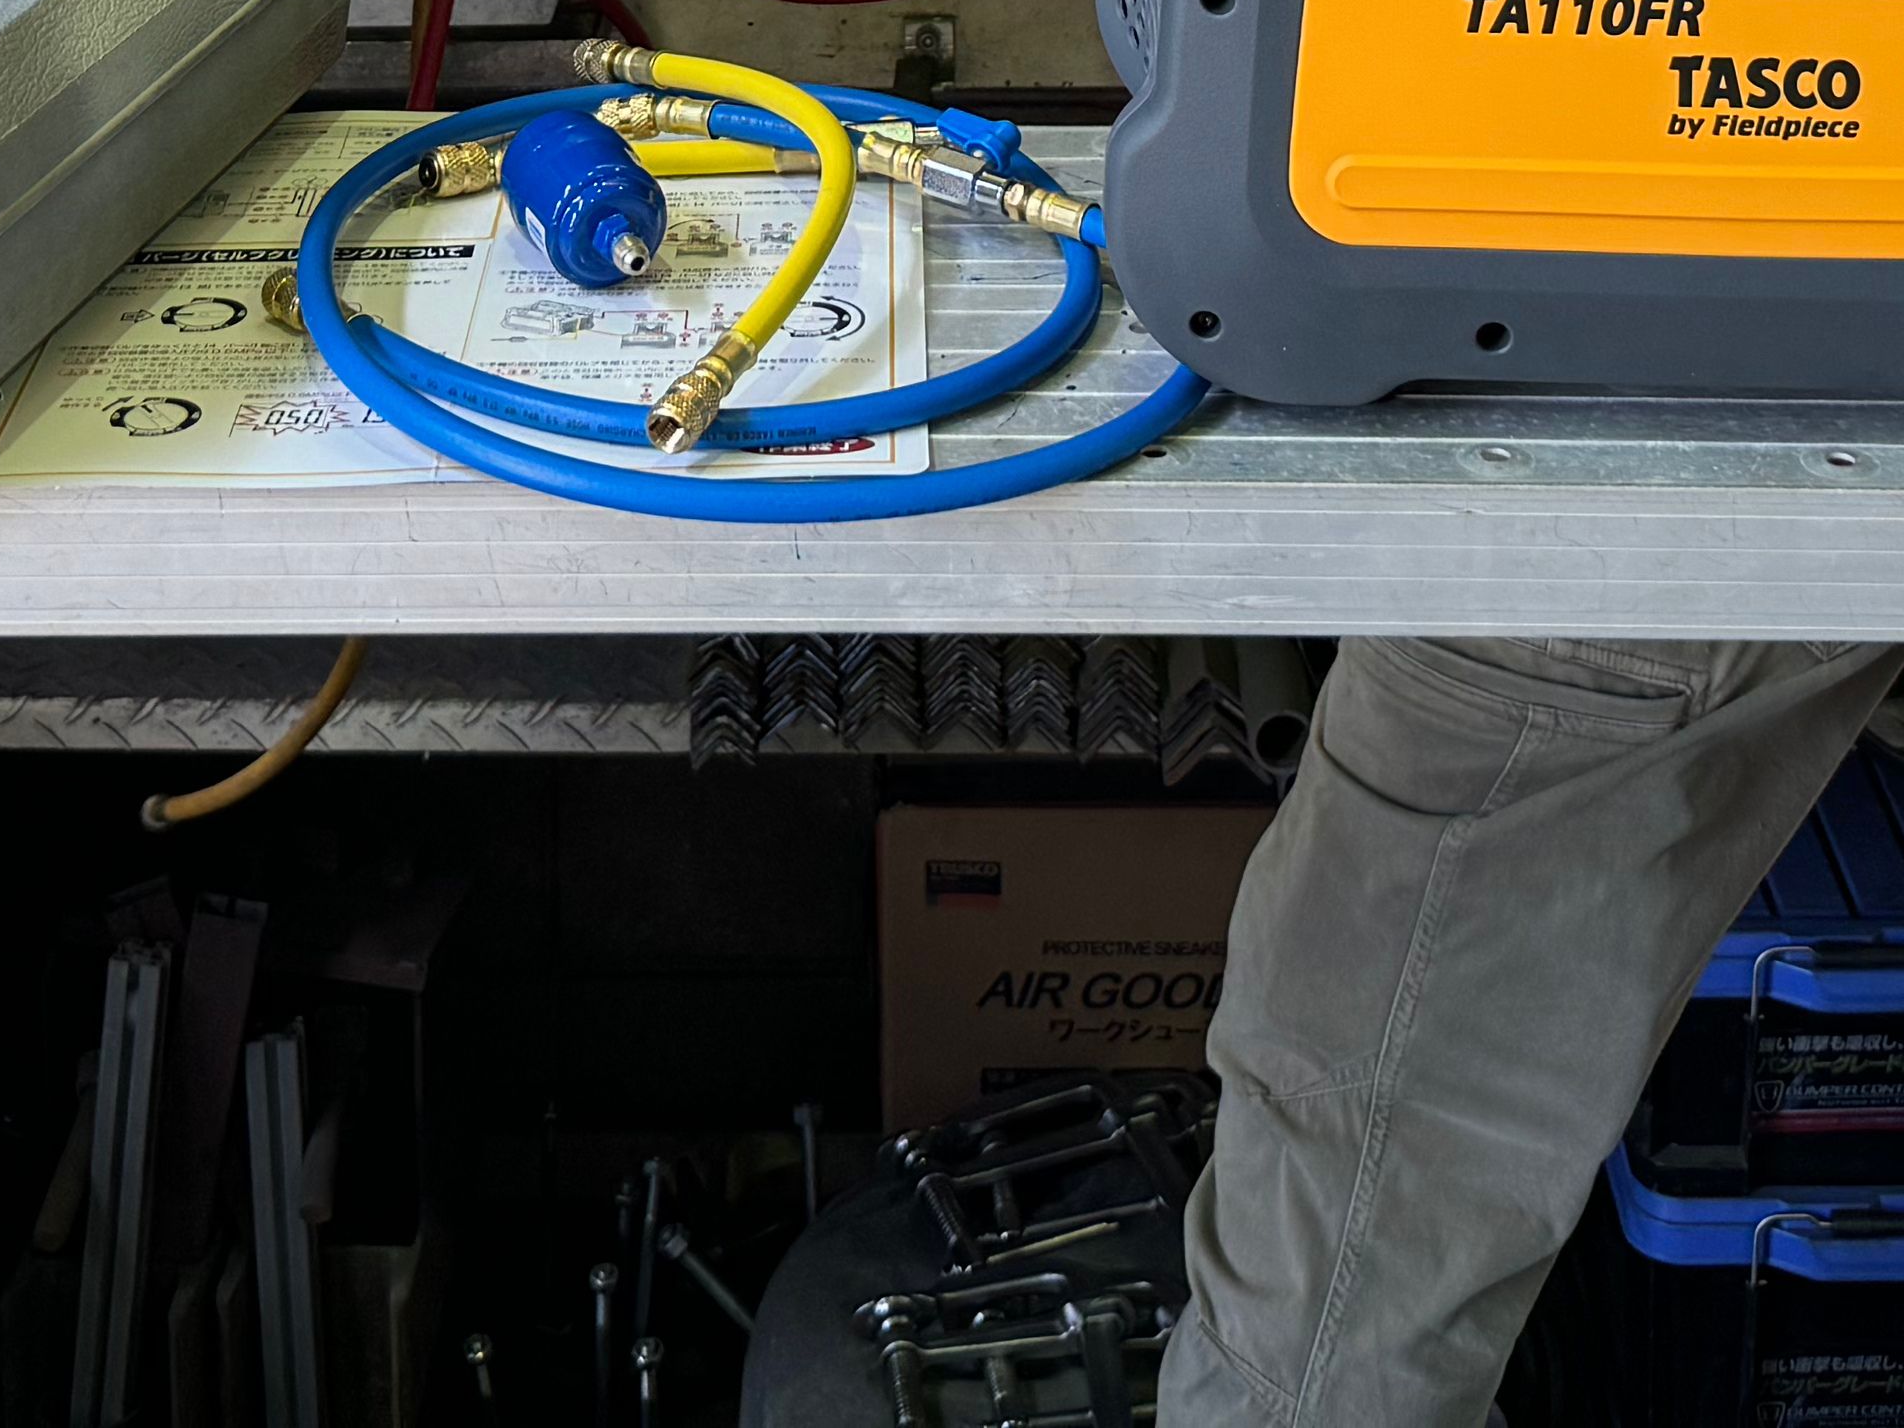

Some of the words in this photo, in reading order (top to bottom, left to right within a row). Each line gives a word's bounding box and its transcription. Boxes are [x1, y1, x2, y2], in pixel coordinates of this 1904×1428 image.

[1668, 55, 1861, 110] TASCO
[1668, 113, 1706, 141] by
[1712, 113, 1861, 141] Fieldpiece
[1041, 940, 1154, 957] PROTECTIVE
[976, 971, 1070, 1010] AIR
